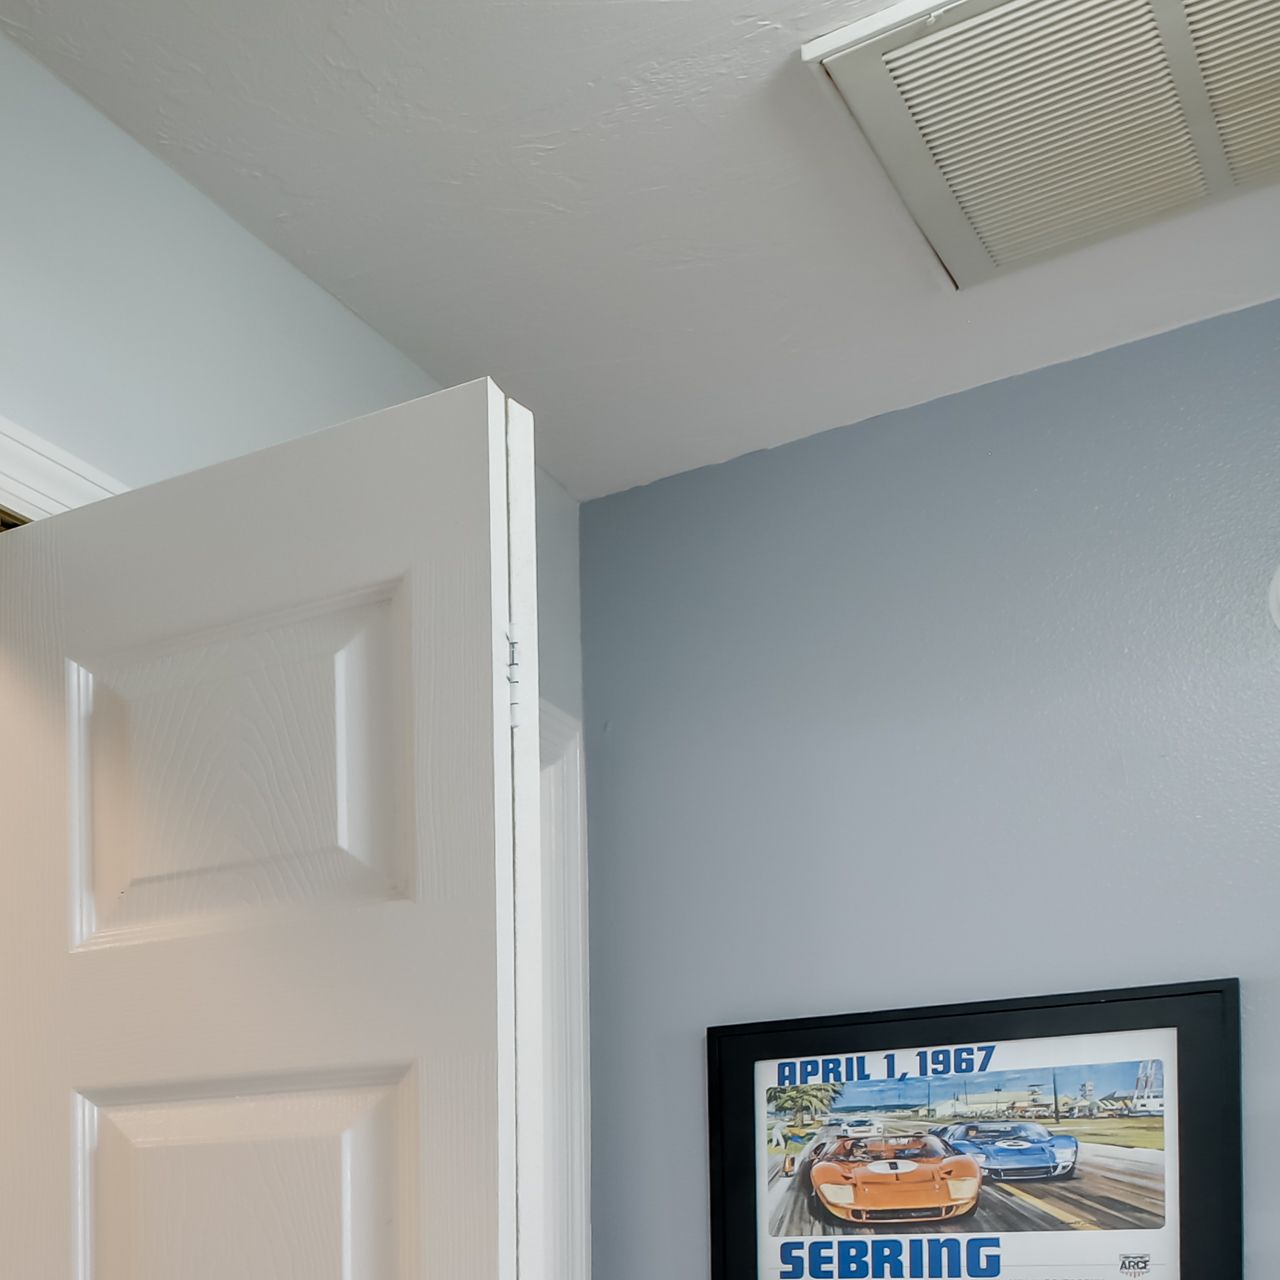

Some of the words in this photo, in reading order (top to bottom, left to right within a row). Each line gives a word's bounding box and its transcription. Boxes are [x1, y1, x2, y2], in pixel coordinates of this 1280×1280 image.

[777, 1056, 871, 1087] APRIL
[883, 1054, 908, 1082] 1,
[916, 1045, 997, 1076] 1967
[780, 1237, 1001, 1279] SEBRING
